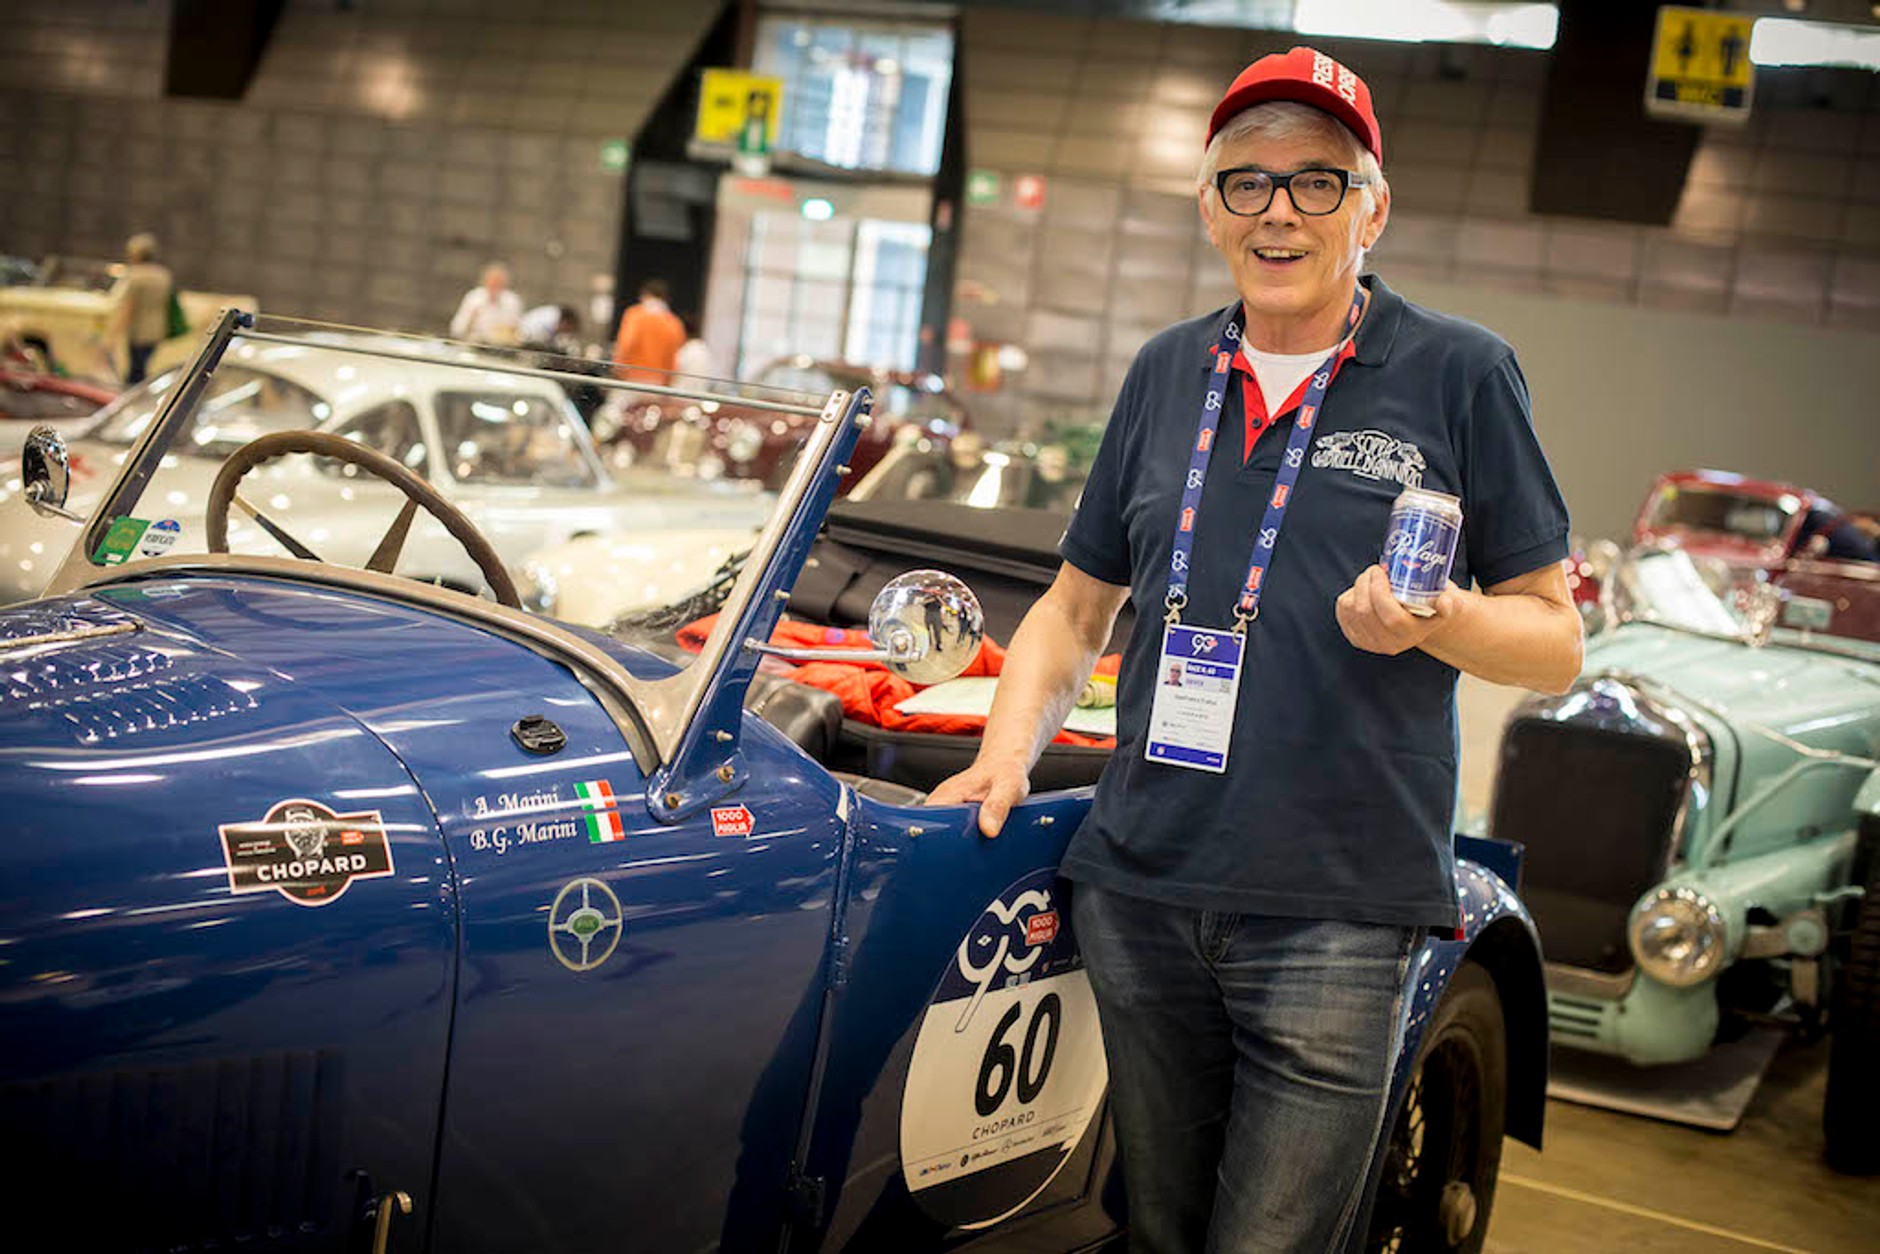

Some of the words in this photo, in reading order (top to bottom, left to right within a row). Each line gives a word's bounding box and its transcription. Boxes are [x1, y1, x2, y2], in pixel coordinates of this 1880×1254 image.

[475, 796, 495, 816] A.
[498, 784, 559, 811] Marini
[716, 811, 743, 822] 1000
[718, 822, 748, 833] MIGLIA
[470, 826, 513, 854] B.G.
[517, 816, 578, 845] Marini
[257, 854, 367, 881] CHOPARD
[1031, 914, 1054, 929] 1000
[1028, 928, 1053, 943] MIGLIA
[975, 992, 1061, 1117] 60
[972, 1111, 1035, 1140] CHOPARD
